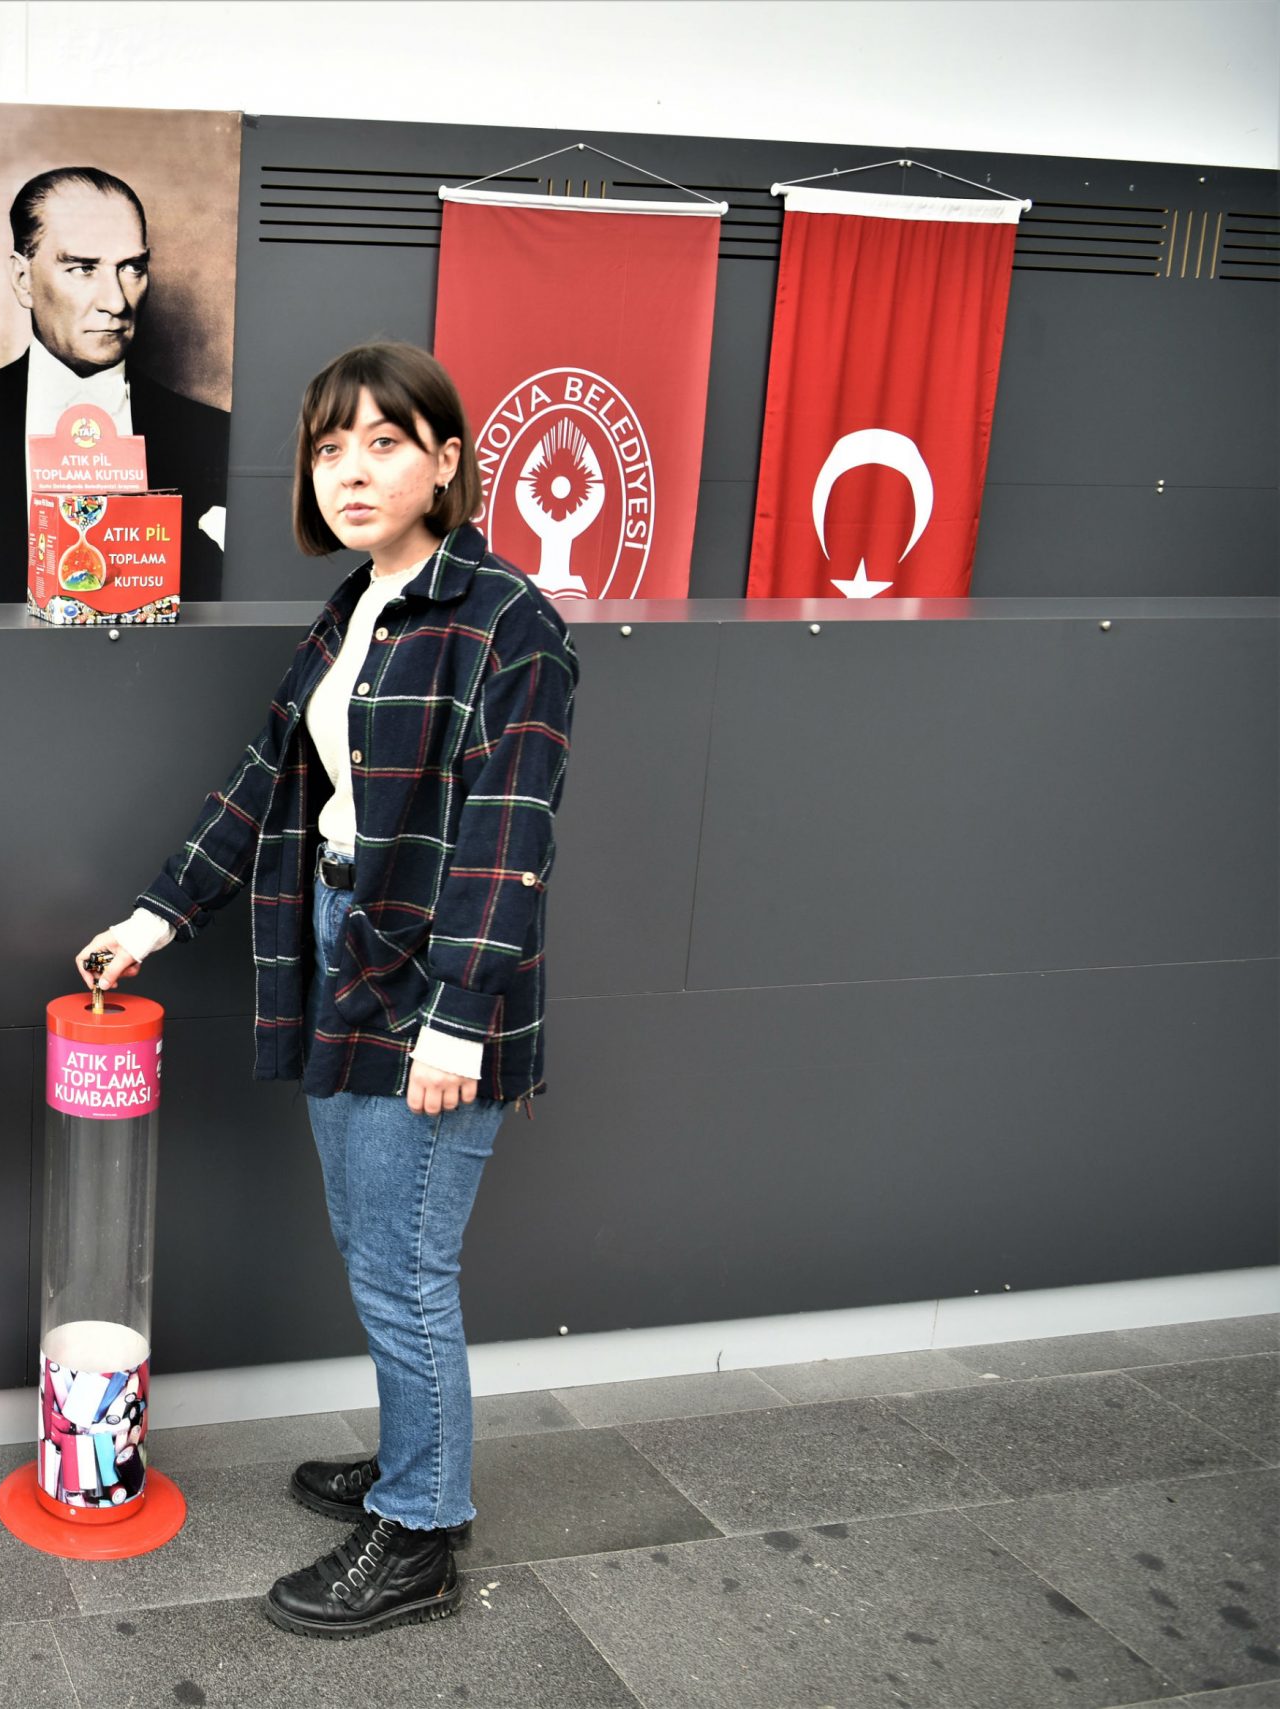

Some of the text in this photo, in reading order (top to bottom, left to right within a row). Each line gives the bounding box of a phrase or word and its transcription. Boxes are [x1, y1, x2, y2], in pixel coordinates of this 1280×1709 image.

[61, 453, 112, 467] ATIK PİL
[564, 376, 650, 550] BELEDİYESİ
[33, 468, 144, 481] TOPLAMA KUTUSU
[103, 523, 171, 542] ATIK PİL
[109, 553, 166, 564] TOPLAMA
[114, 576, 163, 587] KUTUSU
[66, 1050, 141, 1071] ATIK PİL
[61, 1067, 146, 1089] TOPLAMA
[55, 1083, 151, 1108] KUMBARASI
